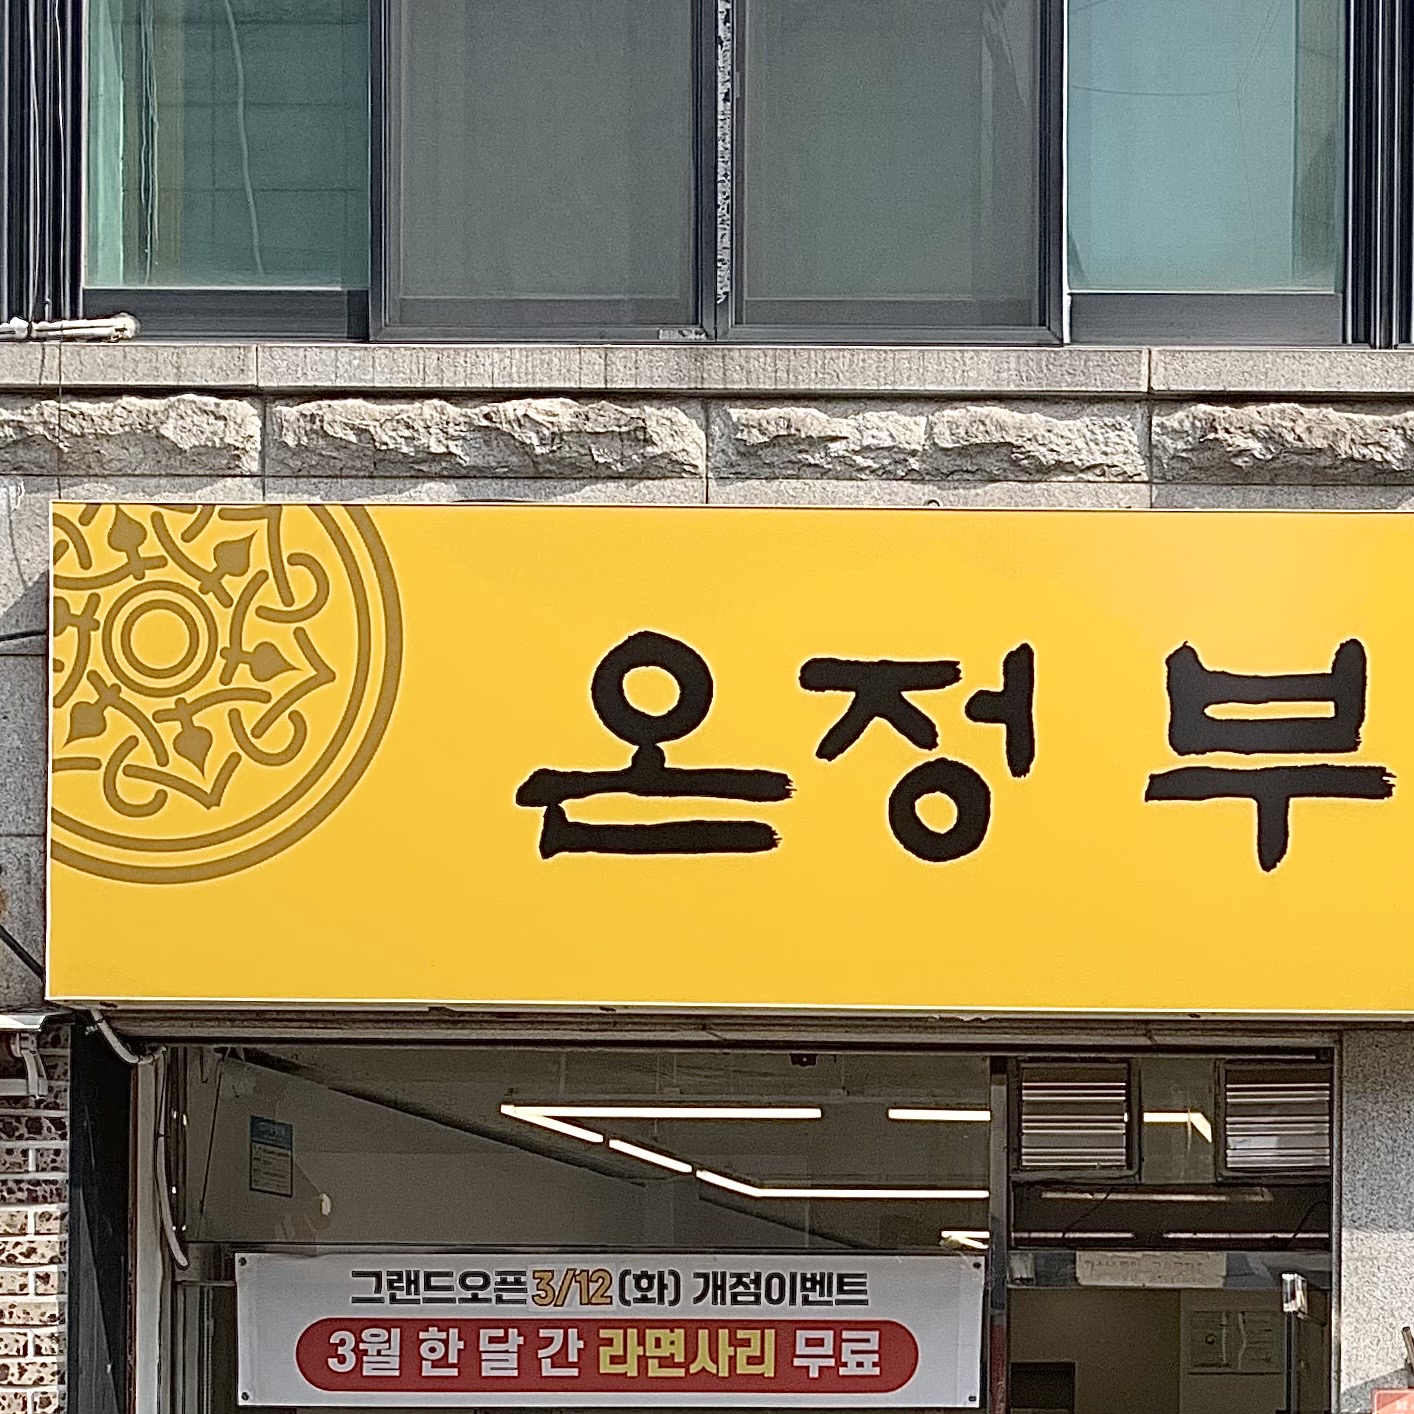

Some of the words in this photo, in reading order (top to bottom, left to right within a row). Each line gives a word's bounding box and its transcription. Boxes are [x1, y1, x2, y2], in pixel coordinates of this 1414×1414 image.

[516, 631, 1034, 861] 온정
[693, 1271, 869, 1306] 개점이벤트
[327, 1328, 400, 1376] 3월
[599, 1328, 776, 1377] 라면사리
[793, 1330, 881, 1378] 무료
